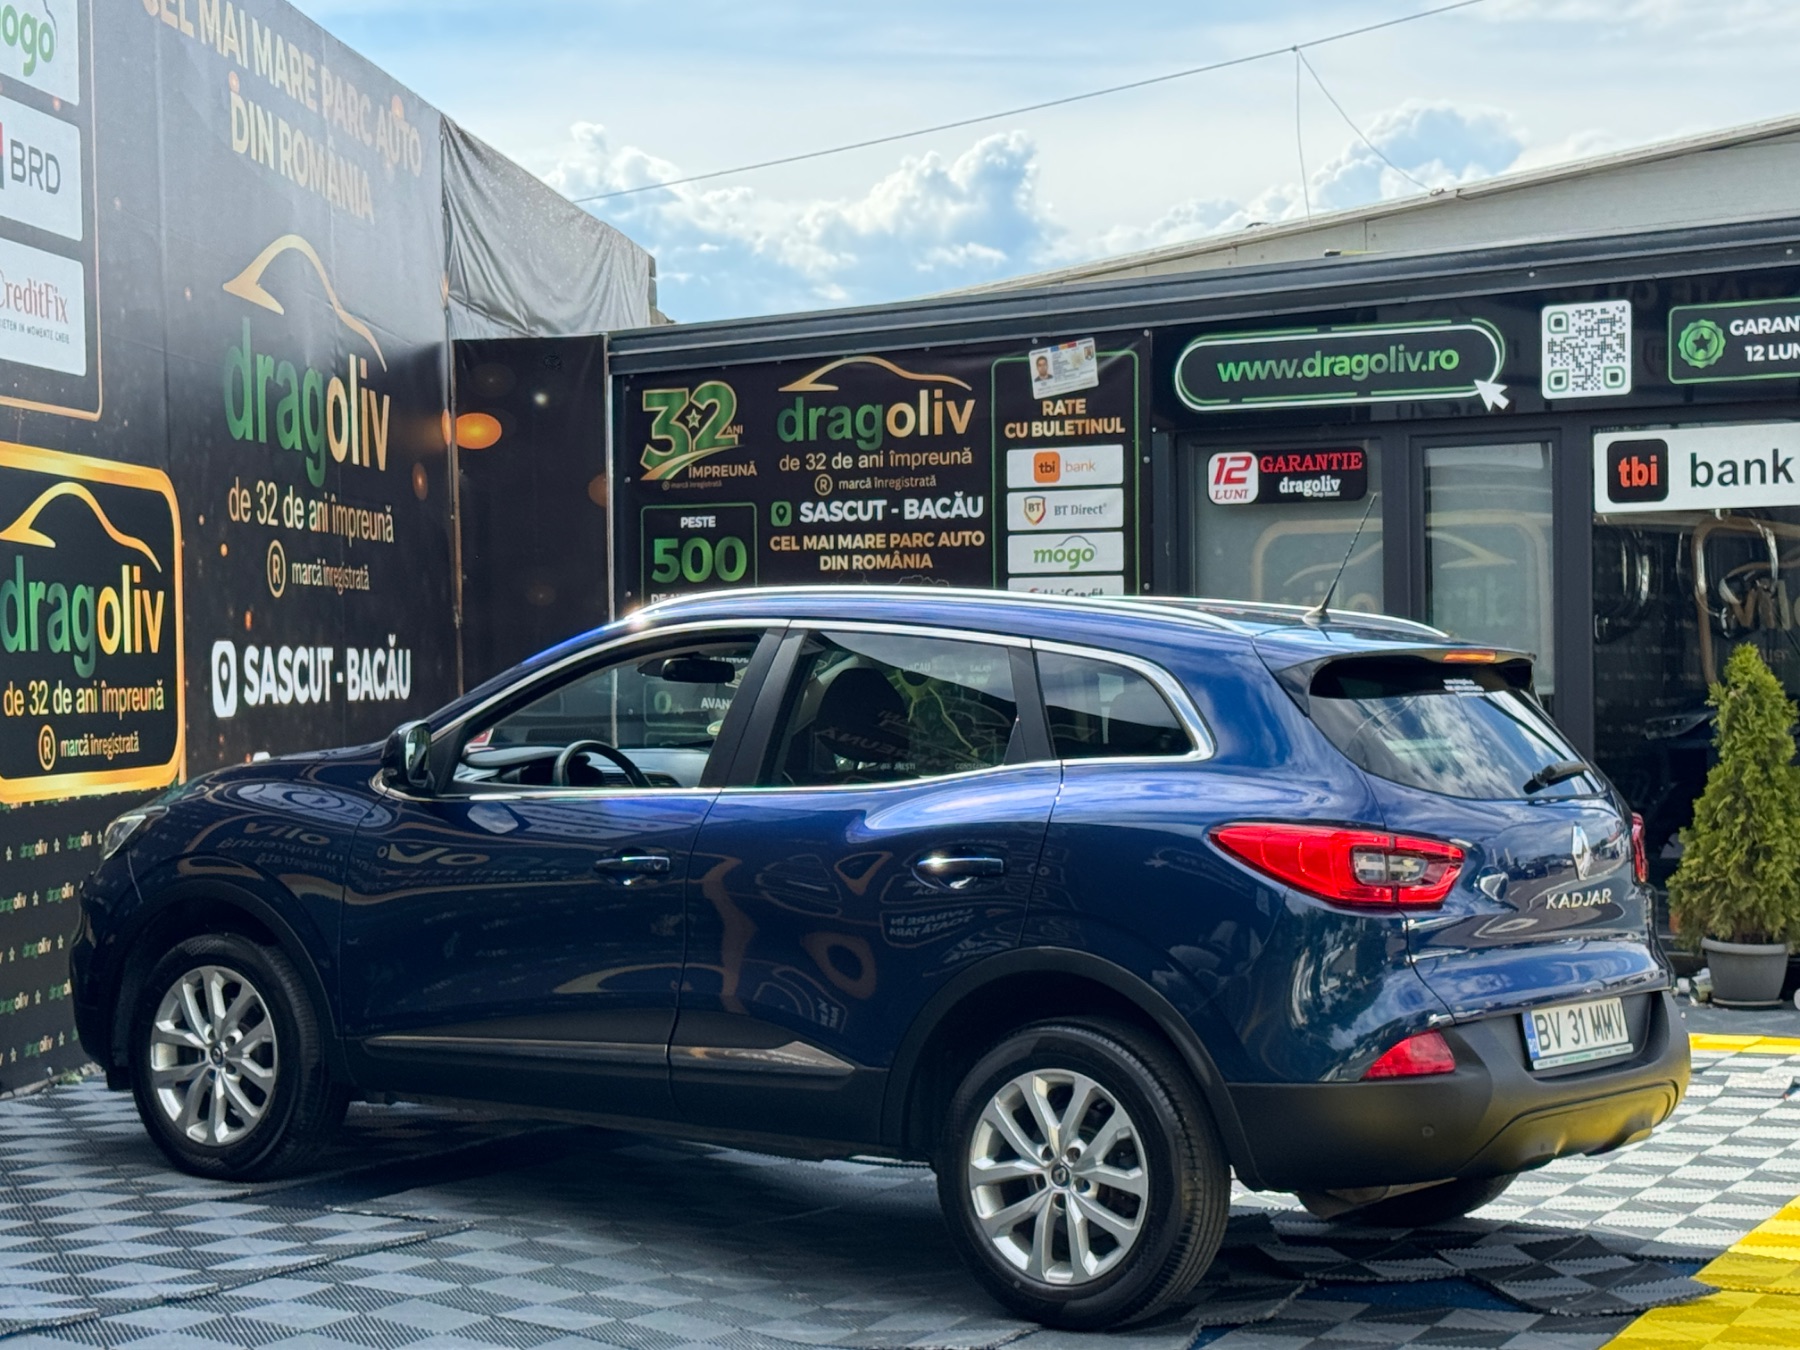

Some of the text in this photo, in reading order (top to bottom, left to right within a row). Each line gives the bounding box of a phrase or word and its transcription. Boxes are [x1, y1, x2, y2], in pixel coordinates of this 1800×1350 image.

[199, 0, 248, 69] MAI
[251, 16, 318, 113] MARE
[320, 65, 373, 147] PARC
[376, 104, 422, 178] AUTO
[10, 138, 61, 195] BRD
[229, 90, 375, 226] DIN ROMÂNIA
[1729, 315, 1800, 336] GARAN
[1217, 344, 1460, 382] www.dragoliv.ro
[1744, 345, 1765, 362] 12
[223, 316, 390, 487] dragoliv
[1042, 399, 1087, 416] RATE
[640, 381, 744, 471] 32 ANI
[776, 388, 976, 450] dragoliv
[1004, 417, 1126, 438] CU BULETINUL
[687, 461, 758, 479] ÎMPREUNĂ
[779, 447, 973, 471] de 32 de ani împreună
[1039, 459, 1097, 474] tbi bank
[1214, 452, 1363, 486] 12 GARANTIE
[1618, 448, 1795, 488] tbi bank
[838, 476, 872, 490] marcă
[874, 474, 938, 491] înregistrată
[1214, 489, 1250, 500] LUNI
[1279, 475, 1342, 497] dragoliv
[228, 476, 395, 548] de 32 de ani împreună
[680, 516, 717, 528] PESTE
[799, 500, 887, 524] SASCUT
[903, 491, 985, 521] BACĂU
[1027, 502, 1042, 512] BT
[1054, 505, 1069, 516] BT
[770, 530, 986, 551] CEL MAI MARE PARC AUTO
[651, 536, 747, 583] 500
[819, 550, 933, 571] DIN ROMÂNIA
[1033, 547, 1096, 571] mogo
[291, 558, 322, 586] marcă
[322, 559, 371, 596] înregistrată
[1, 556, 165, 678] dragoliv
[243, 645, 333, 706] SASCUT
[346, 634, 412, 702] BACĂU
[4, 678, 165, 720] de 32 de ani împreună
[701, 697, 733, 710] AVAN
[60, 732, 90, 757] marcă
[90, 730, 140, 761] înregistrată
[1546, 887, 1612, 910] KADJAR
[1534, 1002, 1623, 1052] BV 31 MMV
